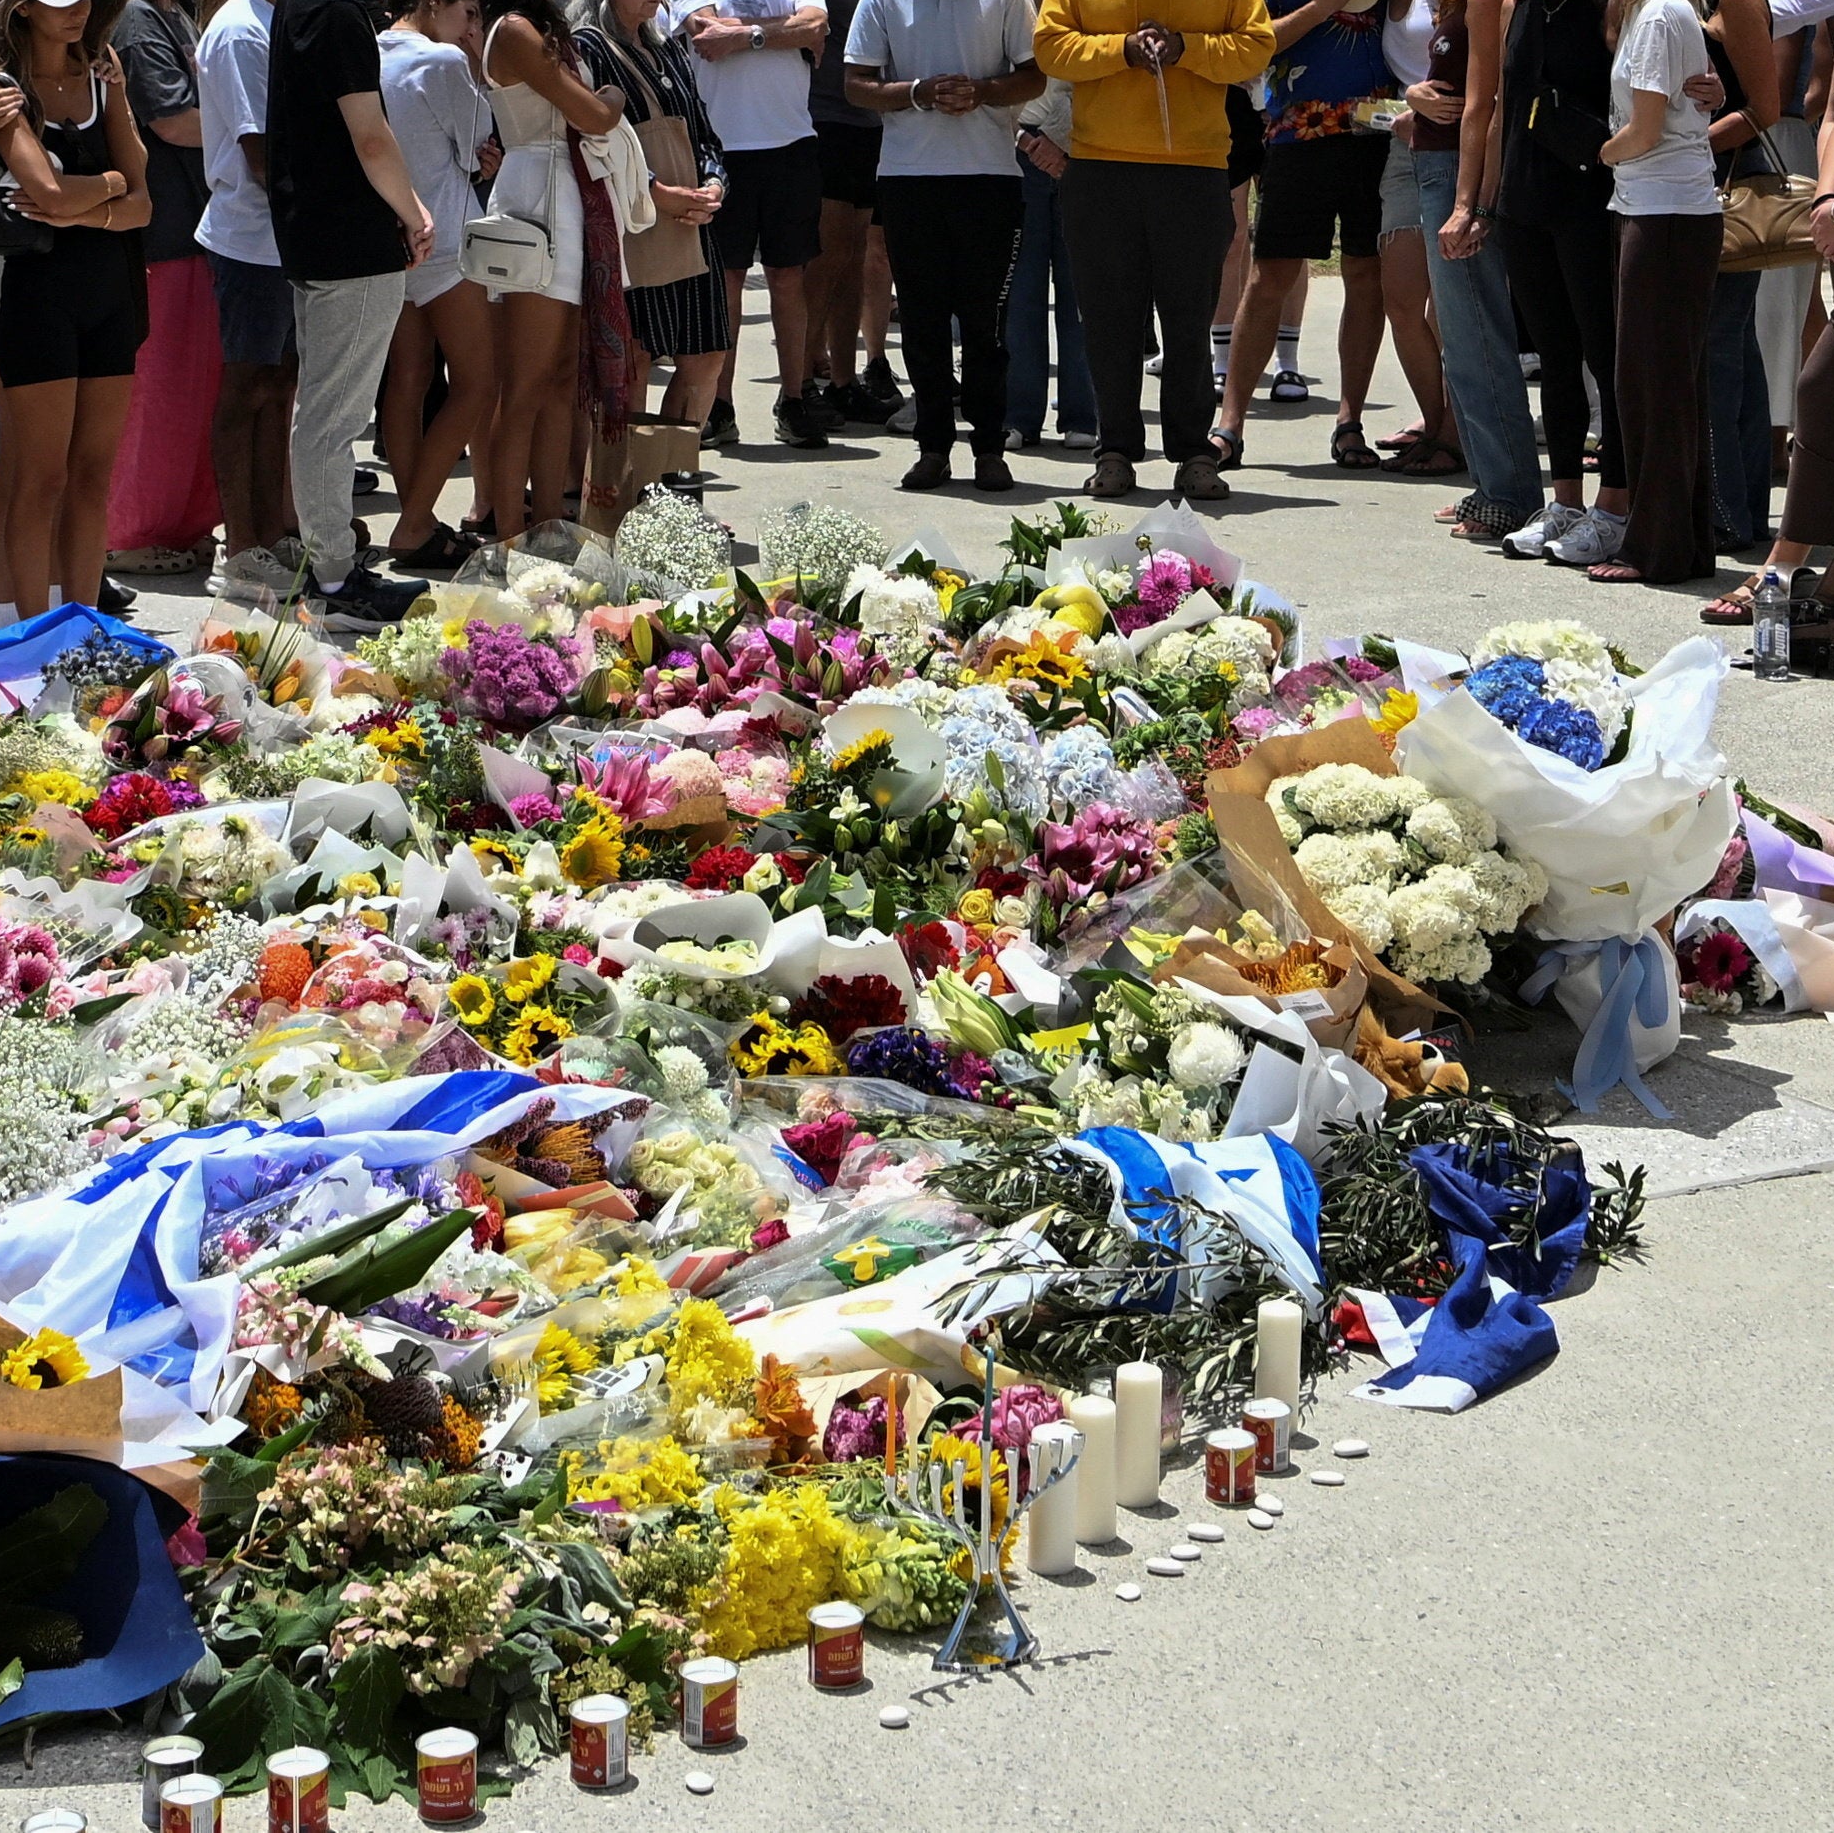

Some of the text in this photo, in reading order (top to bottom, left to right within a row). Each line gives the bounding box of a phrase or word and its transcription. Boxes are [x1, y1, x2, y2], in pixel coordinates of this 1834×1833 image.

[1011, 228, 1022, 261] POLO
[998, 263, 1015, 300] RALPH
[1774, 623, 1789, 657] pump
